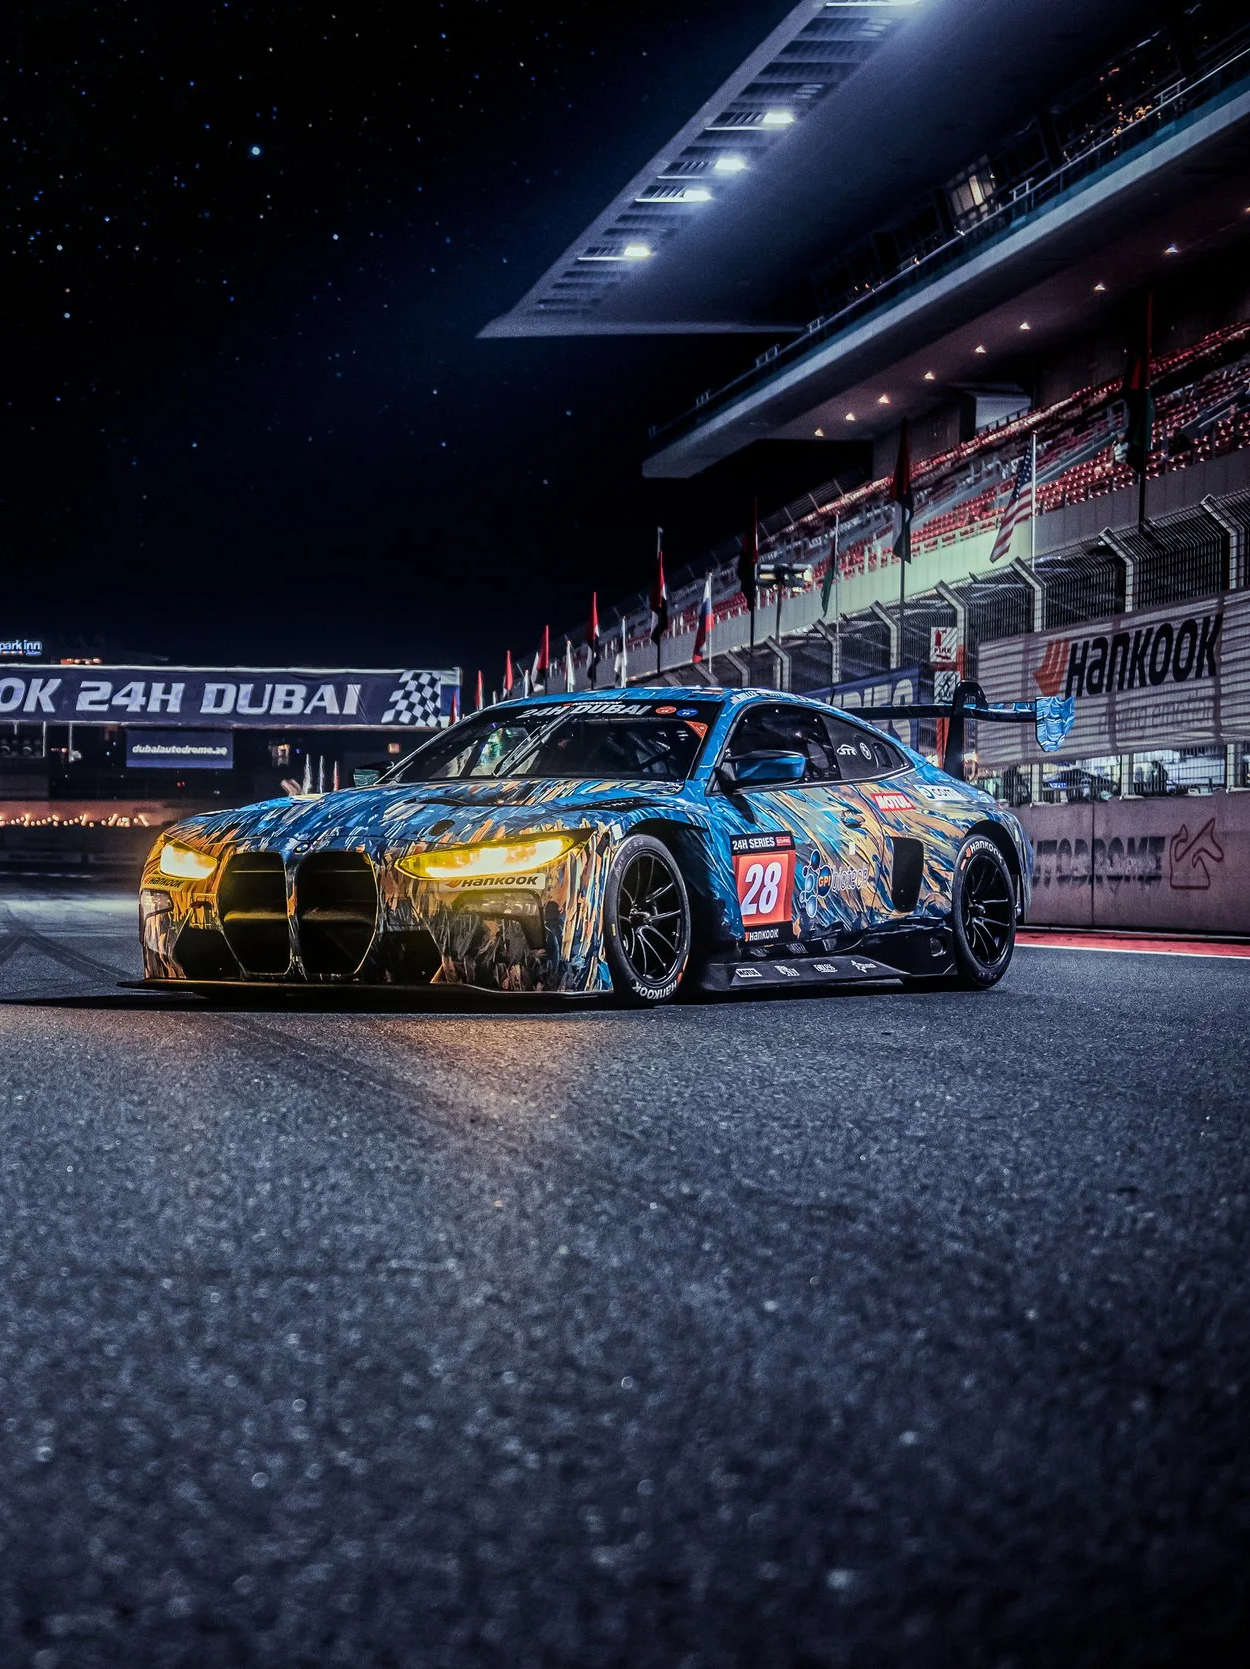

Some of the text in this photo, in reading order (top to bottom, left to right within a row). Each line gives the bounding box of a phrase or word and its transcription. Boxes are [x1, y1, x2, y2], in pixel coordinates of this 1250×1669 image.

[23, 640, 41, 650] inn
[76, 681, 185, 713] 24H
[200, 682, 361, 715] DUBAI
[516, 708, 568, 719] 24H
[570, 704, 652, 715] DUBAI
[132, 744, 227, 756] dubaiautodrome.ae
[874, 795, 913, 809] MOTUL
[732, 840, 748, 850] 24H
[748, 837, 775, 848] SERIES
[1030, 836, 1166, 890] UTODROME
[741, 861, 782, 916] 28
[818, 875, 831, 888] GPI
